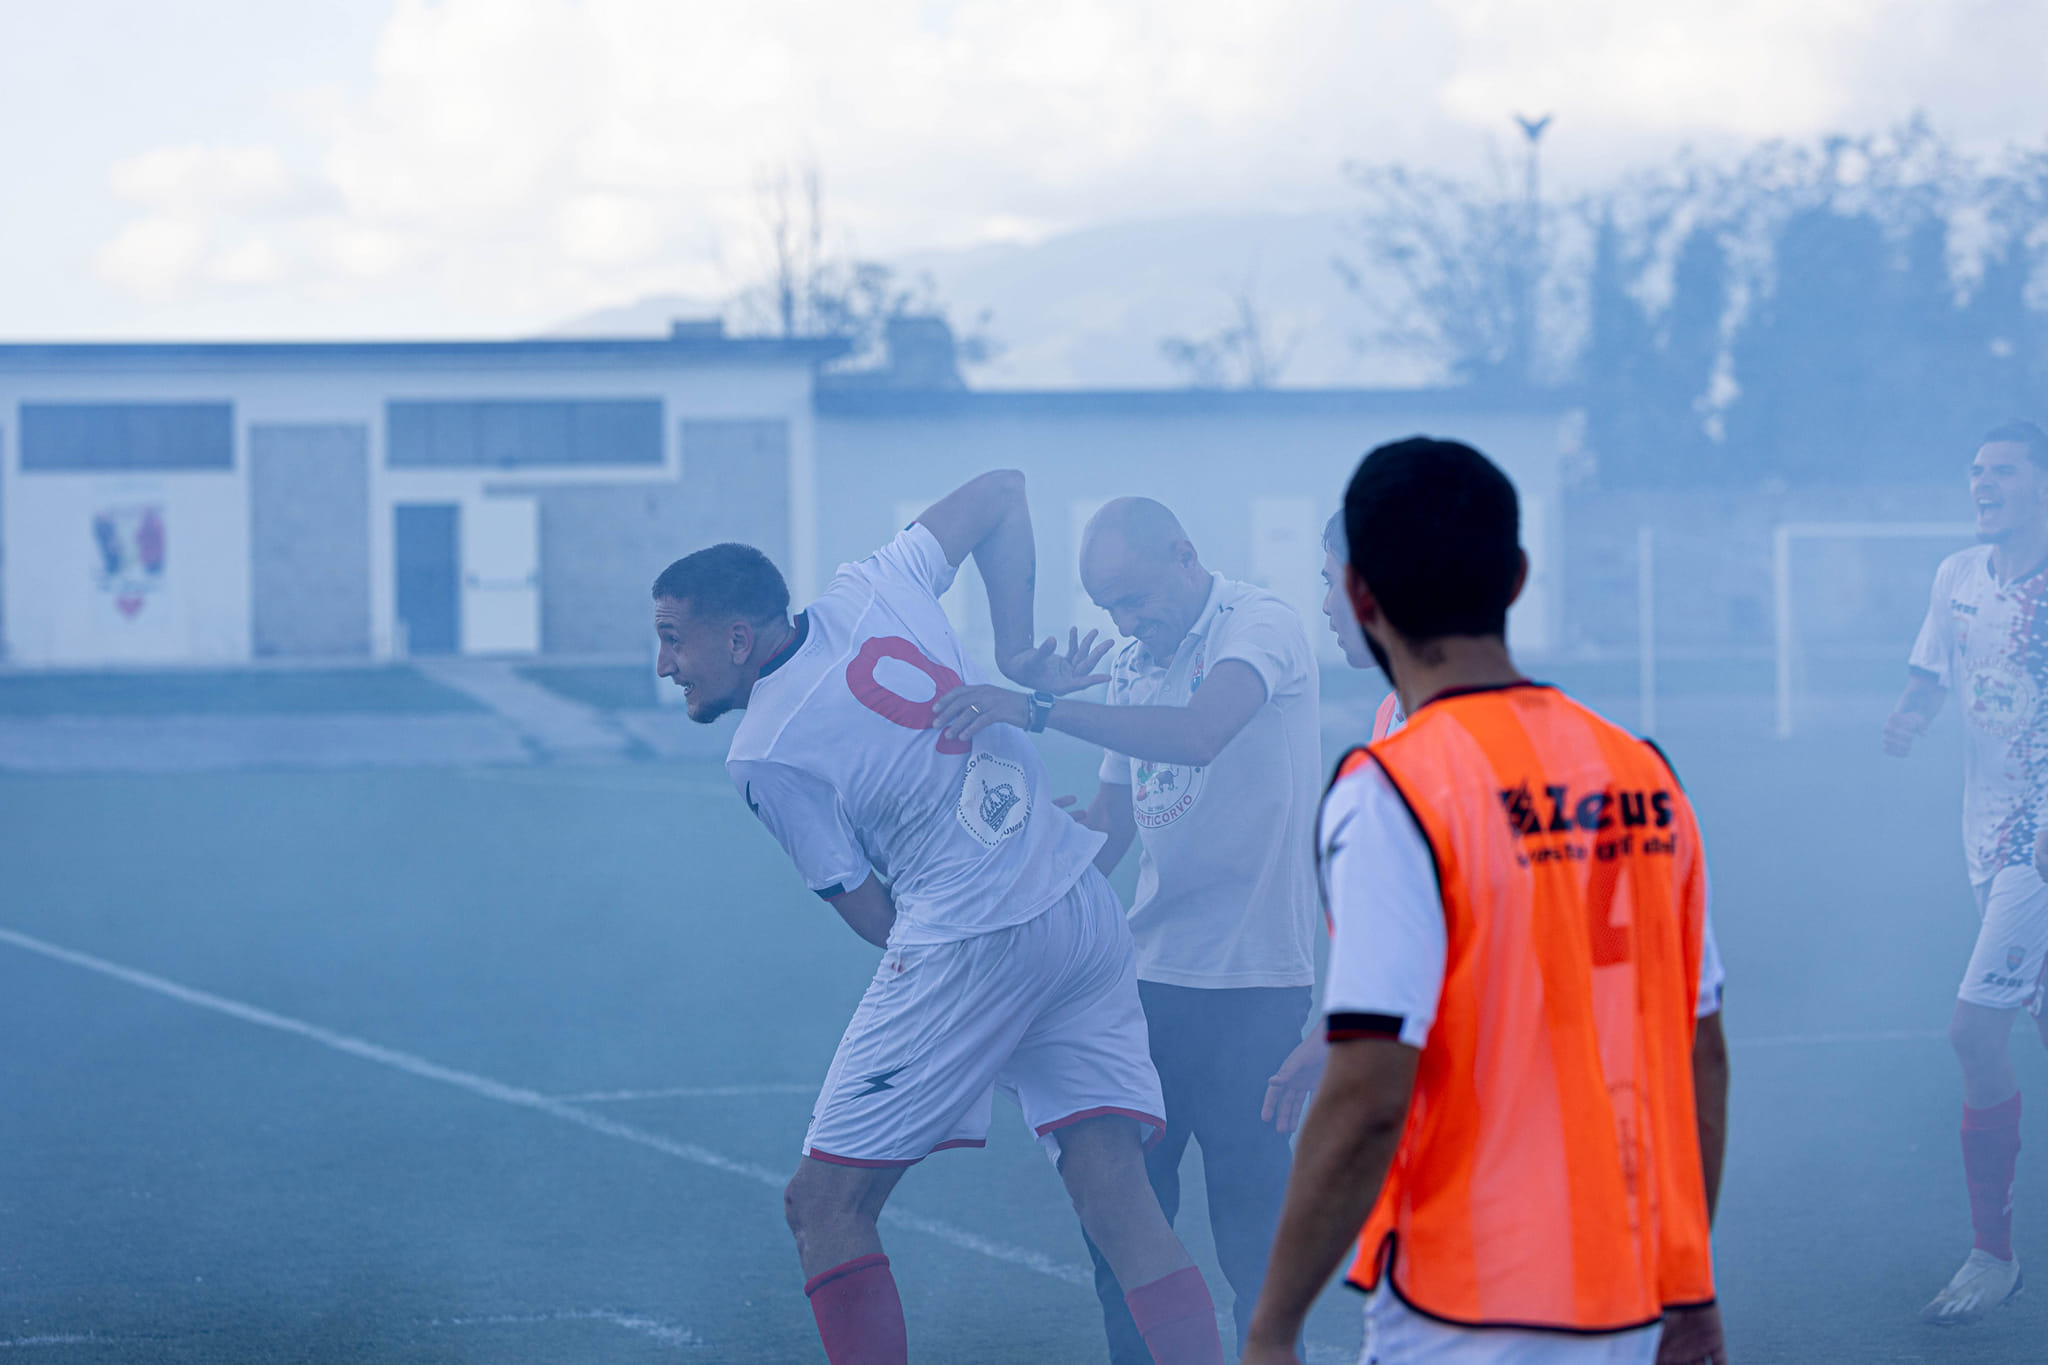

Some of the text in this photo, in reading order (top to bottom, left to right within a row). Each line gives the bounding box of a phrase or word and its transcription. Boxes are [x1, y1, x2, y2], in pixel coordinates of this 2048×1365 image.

[846, 635, 972, 755] 9
[1134, 794, 1193, 826] ONTICORVO
[1546, 784, 1672, 831] Zeus
